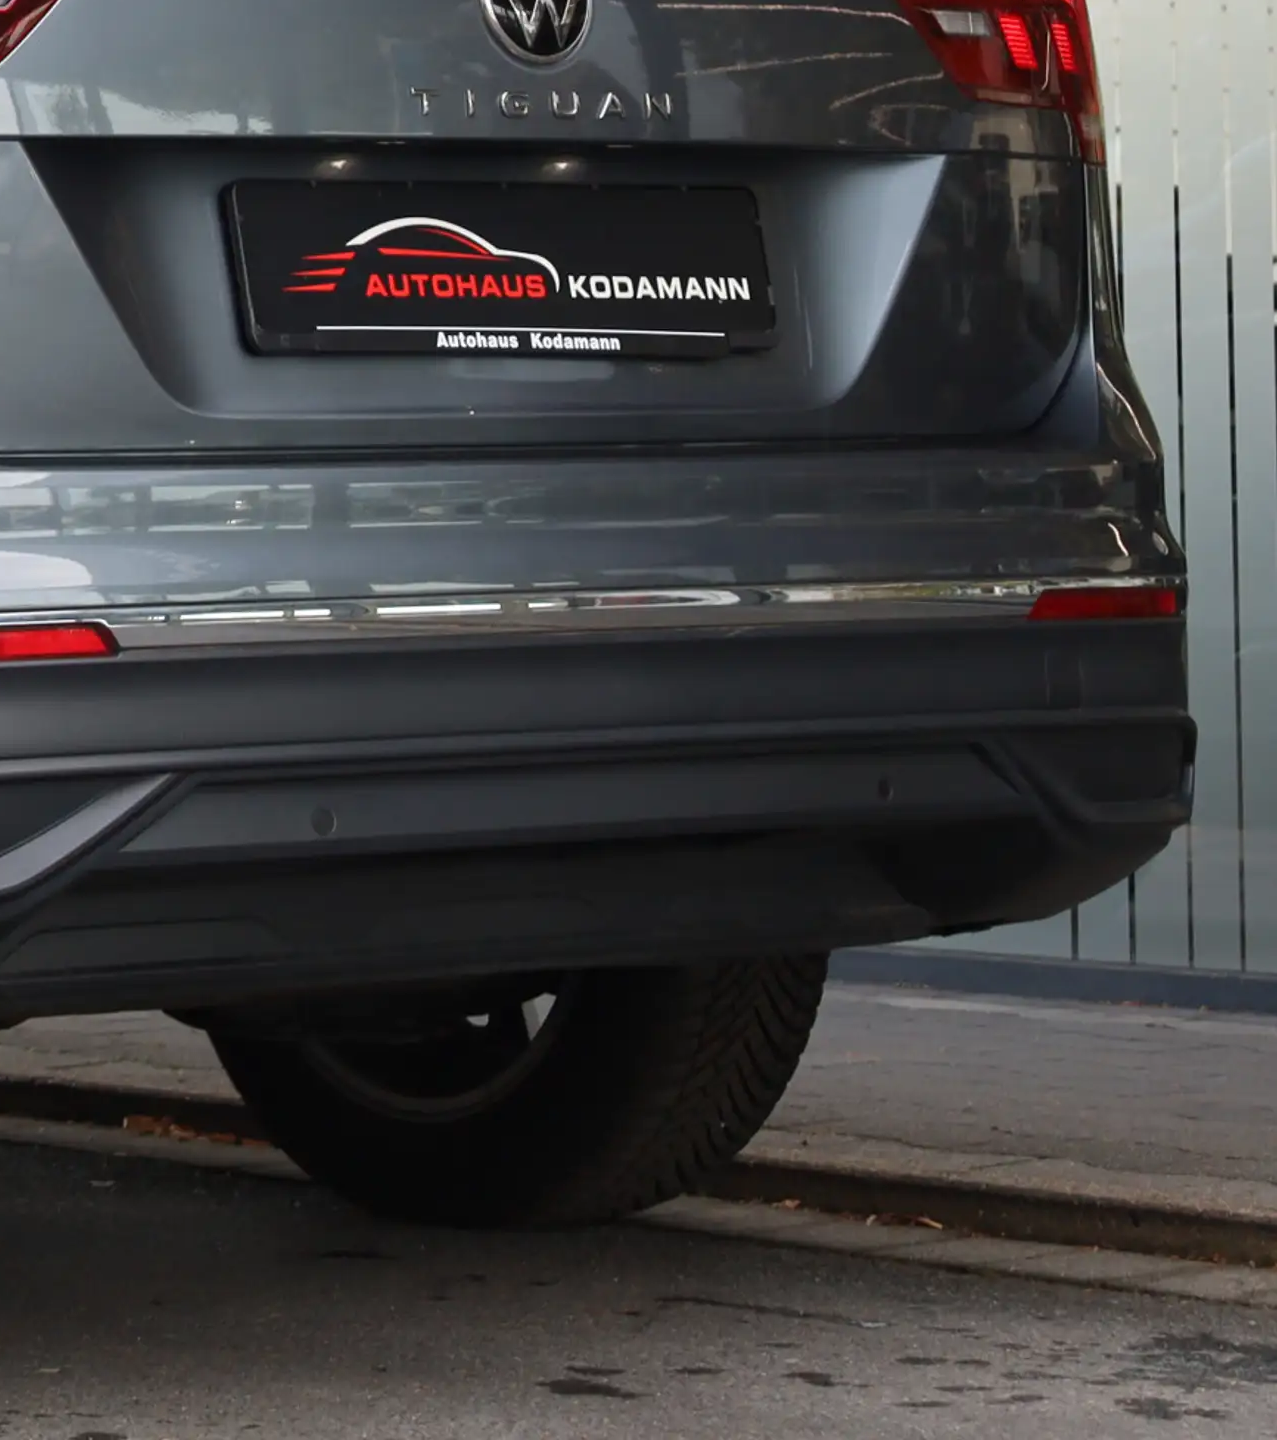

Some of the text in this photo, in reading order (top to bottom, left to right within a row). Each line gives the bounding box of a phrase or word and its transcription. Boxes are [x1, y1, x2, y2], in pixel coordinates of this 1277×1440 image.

[409, 86, 673, 120] TIGUAN
[365, 272, 752, 302] AUTOHAUS KODAMANN
[435, 330, 621, 352] Autohaus Kodamann
